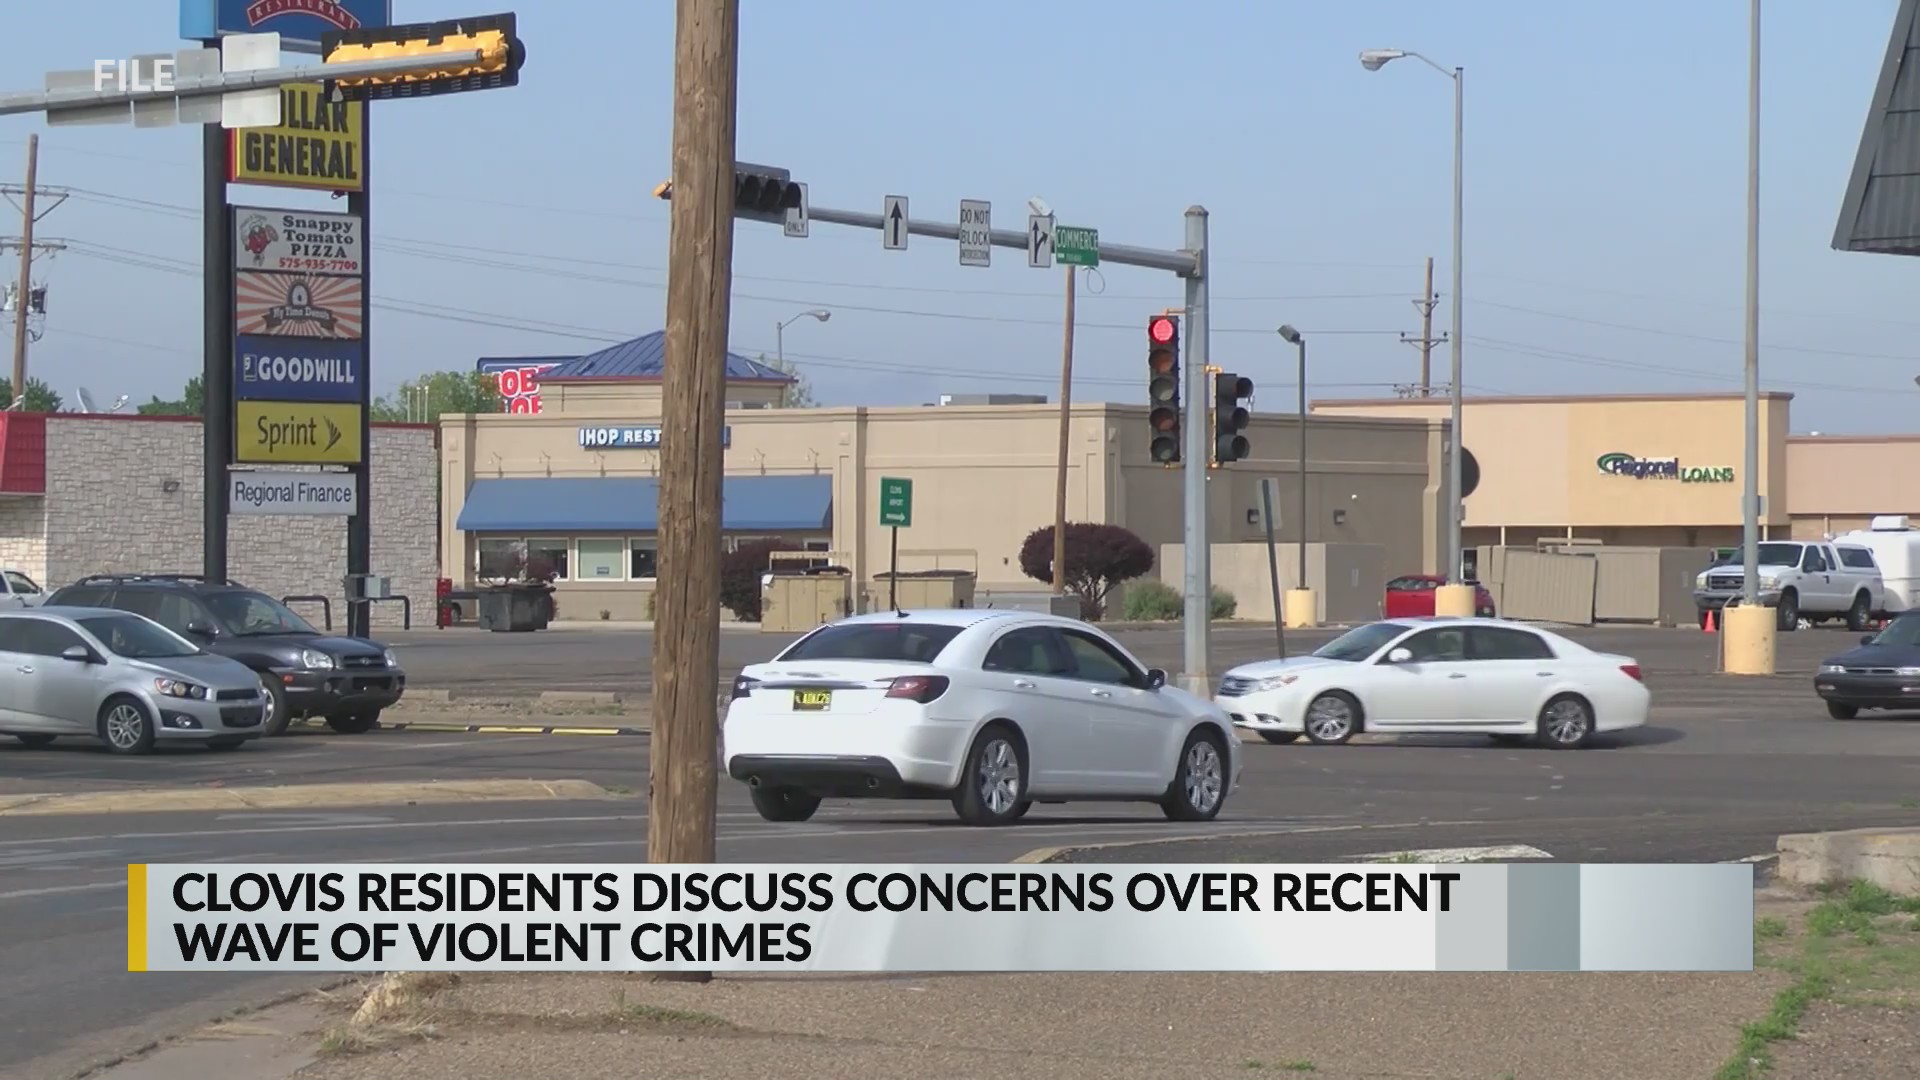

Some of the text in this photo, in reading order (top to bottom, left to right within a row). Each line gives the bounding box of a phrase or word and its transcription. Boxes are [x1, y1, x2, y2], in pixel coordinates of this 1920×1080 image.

[279, 88, 349, 134] LLAR
[245, 131, 357, 180] GENERAL
[282, 215, 353, 233] Snappy
[961, 208, 990, 225] DO NOT
[786, 221, 805, 233] ONLY
[283, 229, 354, 245] Tomato
[961, 230, 990, 246] BLOCK
[1056, 229, 1099, 251] COMMERCE
[290, 243, 347, 258] PIZZA
[279, 257, 358, 270] 575-935-7700
[258, 356, 355, 384] GOODWILL
[257, 416, 317, 453] Sprint
[579, 428, 619, 445] IHOP
[1681, 467, 1734, 483] LOANS
[235, 481, 352, 506] Regional Finance
